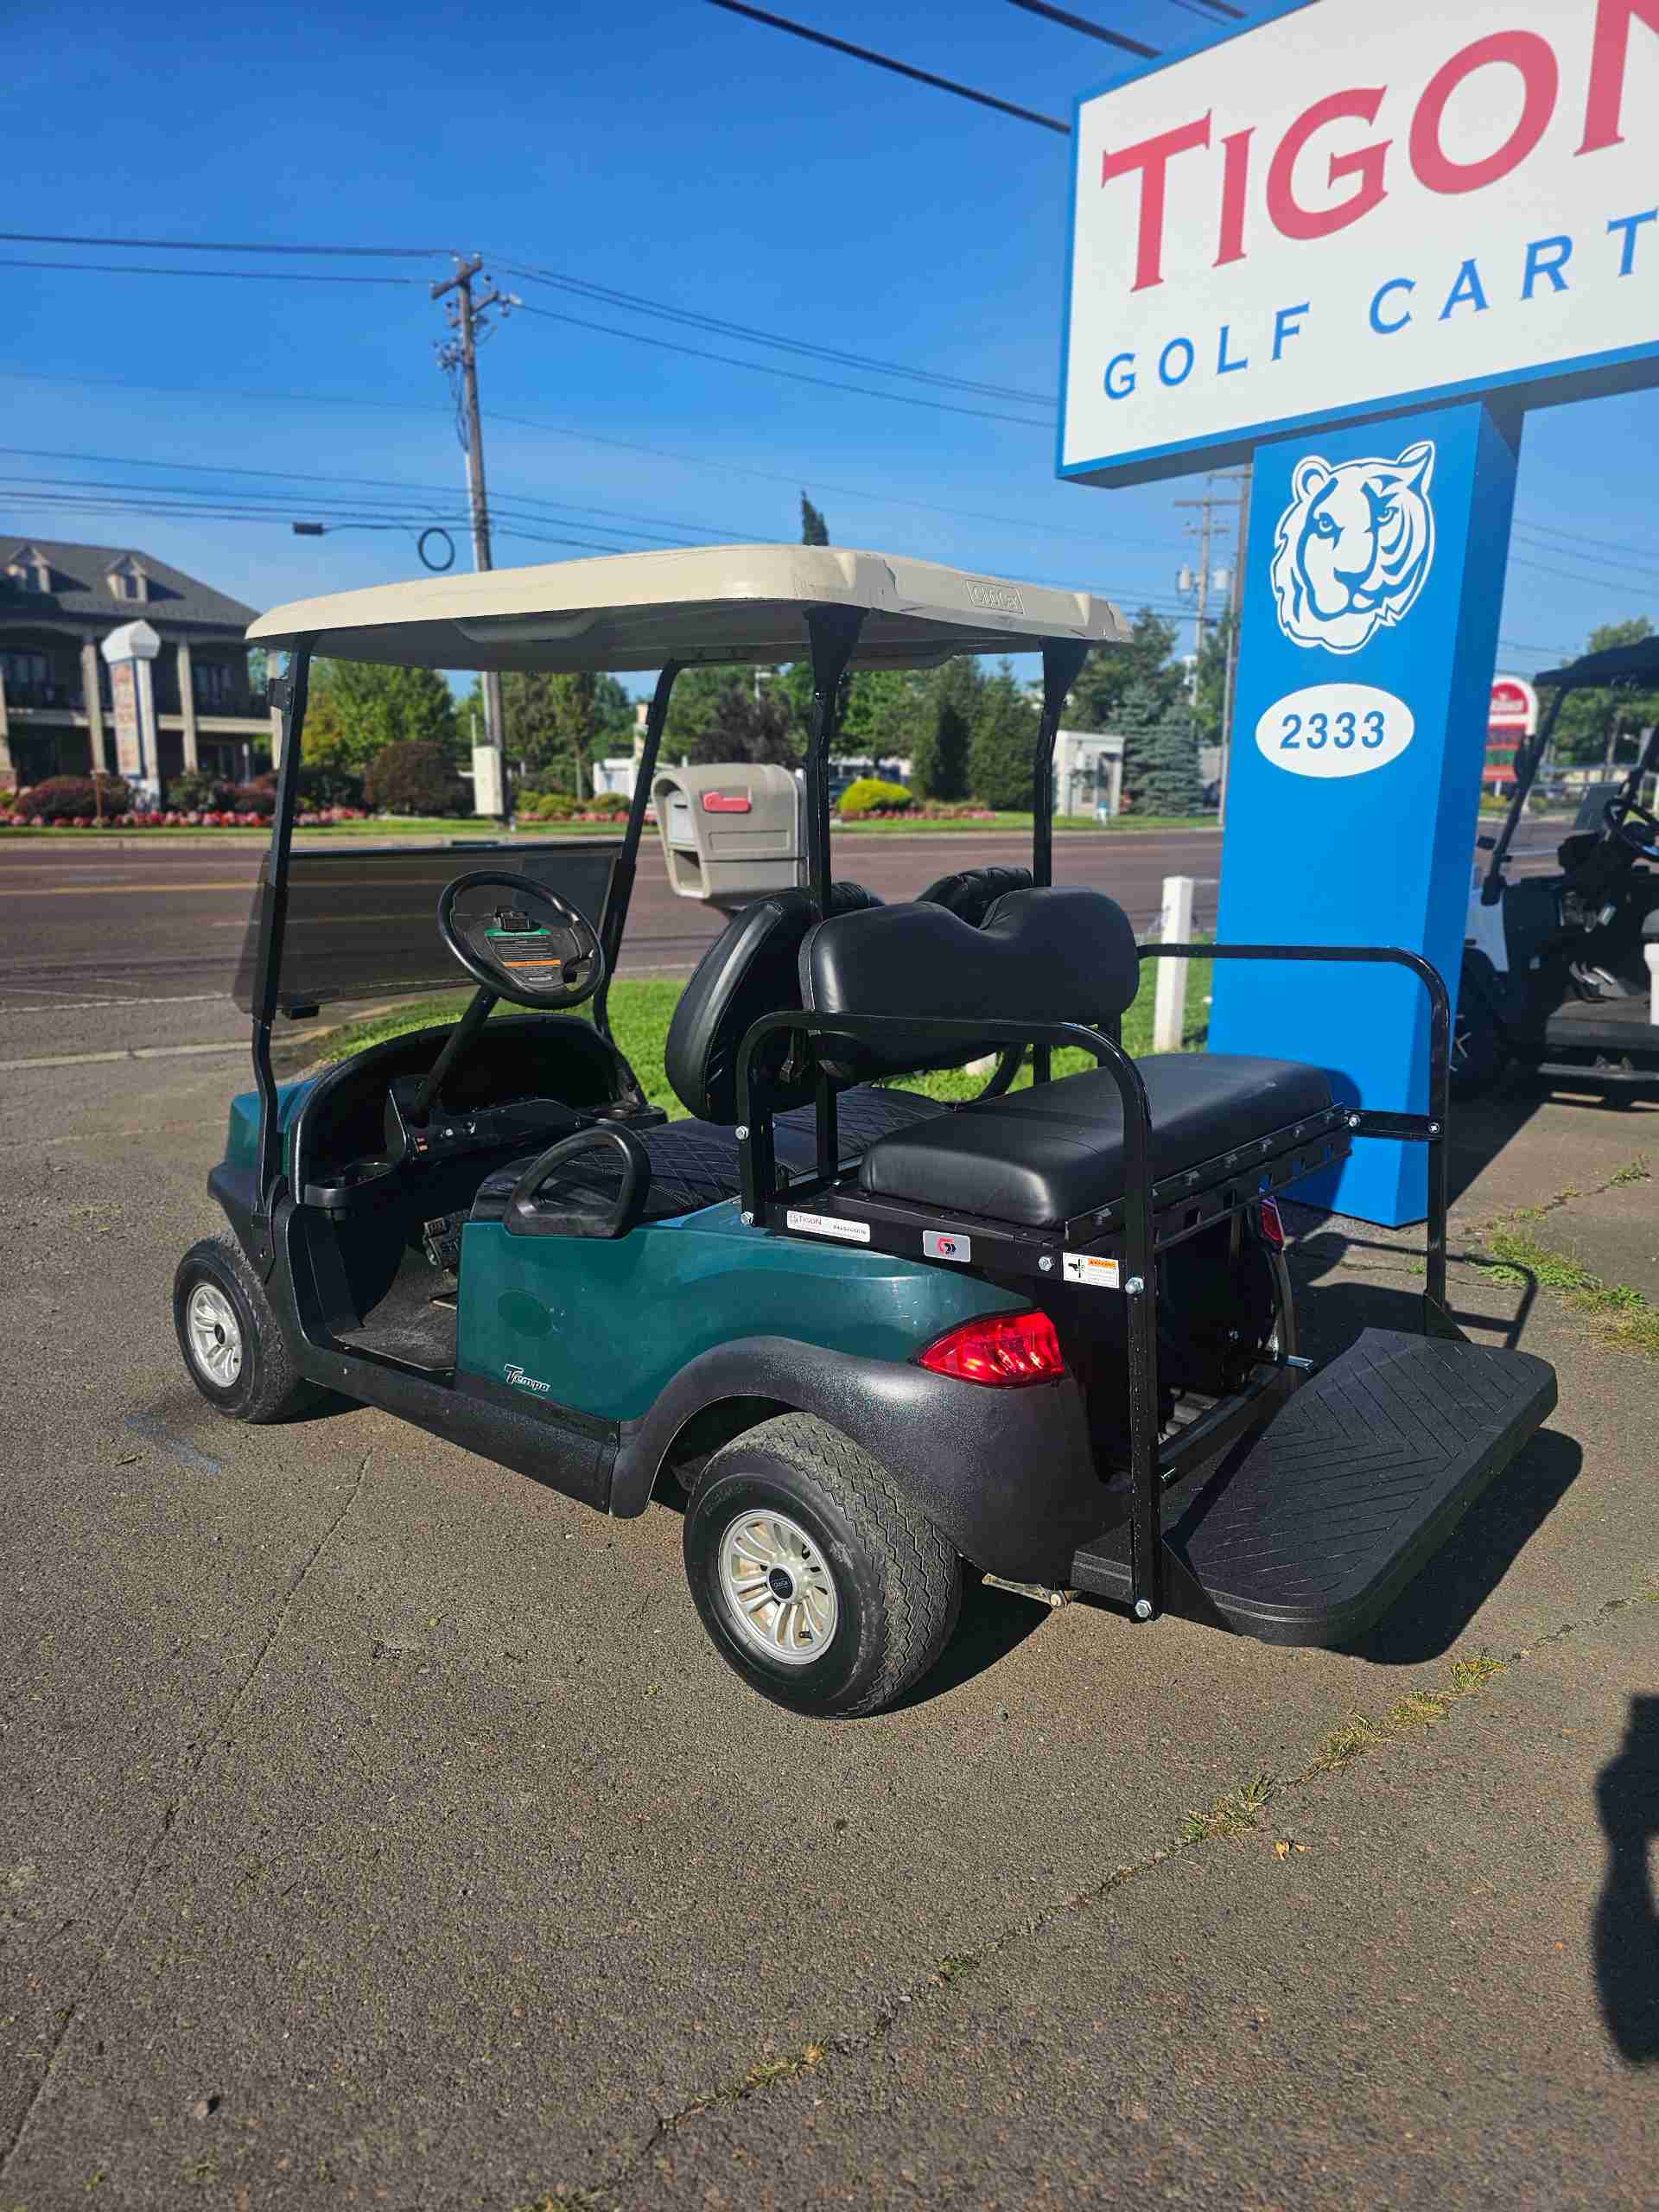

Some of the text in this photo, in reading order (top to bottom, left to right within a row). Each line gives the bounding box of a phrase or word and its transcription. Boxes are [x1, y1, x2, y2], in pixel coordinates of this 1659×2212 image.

[1103, 207, 1659, 402] GOLF CART
[1280, 710, 1385, 749] 2333
[504, 1363, 551, 1392] Tempo
